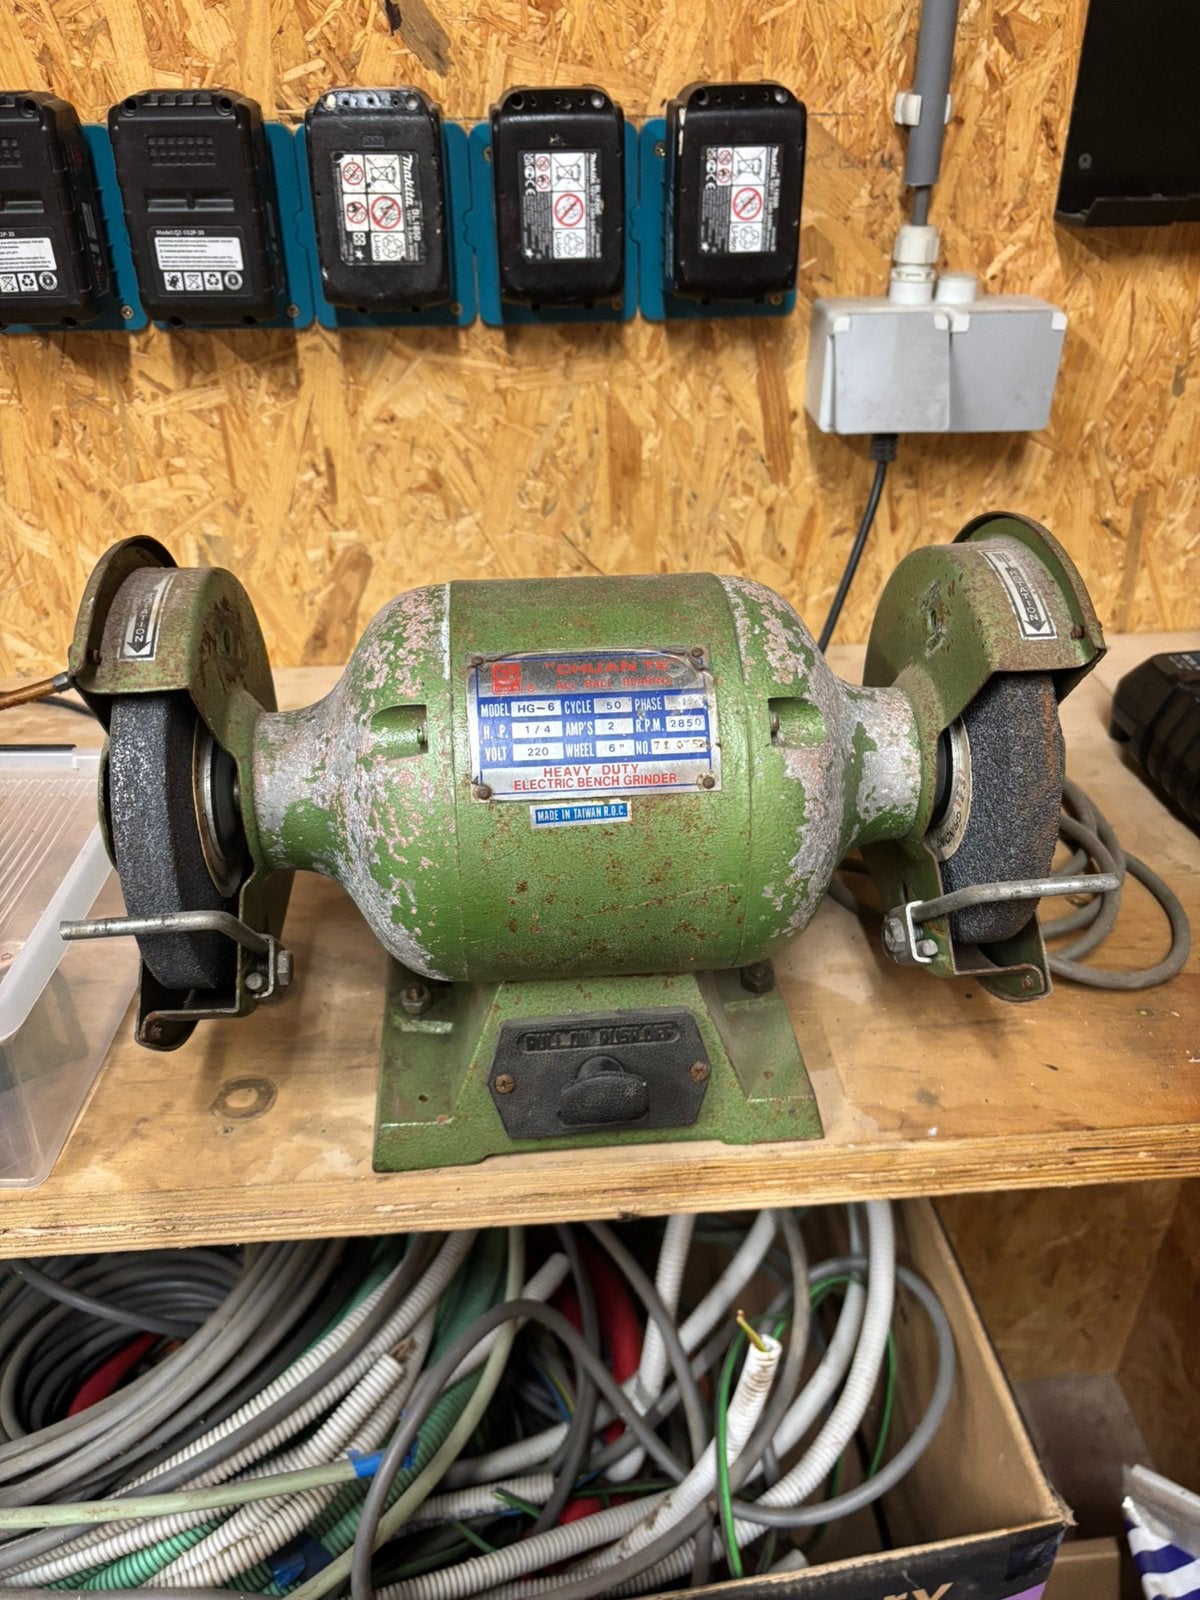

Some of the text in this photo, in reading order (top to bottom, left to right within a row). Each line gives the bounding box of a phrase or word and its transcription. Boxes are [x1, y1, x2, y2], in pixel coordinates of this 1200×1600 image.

[403, 154, 416, 208] makita
[373, 234, 381, 260] Li-ion
[555, 675, 674, 690] ALL BALL BEARING
[480, 703, 511, 718] MODEL
[517, 702, 555, 713] HG-6
[564, 699, 592, 714] CYCLE
[606, 701, 622, 710] 50
[634, 696, 663, 711] PHASE
[565, 720, 593, 736] AMP'S
[607, 721, 614, 730] 2
[635, 717, 665, 732] R.P.M.
[670, 717, 702, 728] 2850
[484, 745, 507, 761] VOLT
[527, 747, 549, 757] 220
[565, 742, 594, 758] WHEEL
[635, 740, 652, 754] NO.
[543, 764, 639, 778] HEAVY DUTY
[513, 773, 677, 791] ELECTRIC BENCH GRINDER
[537, 804, 627, 822] MADE IN TAIWAN R.O.C.
